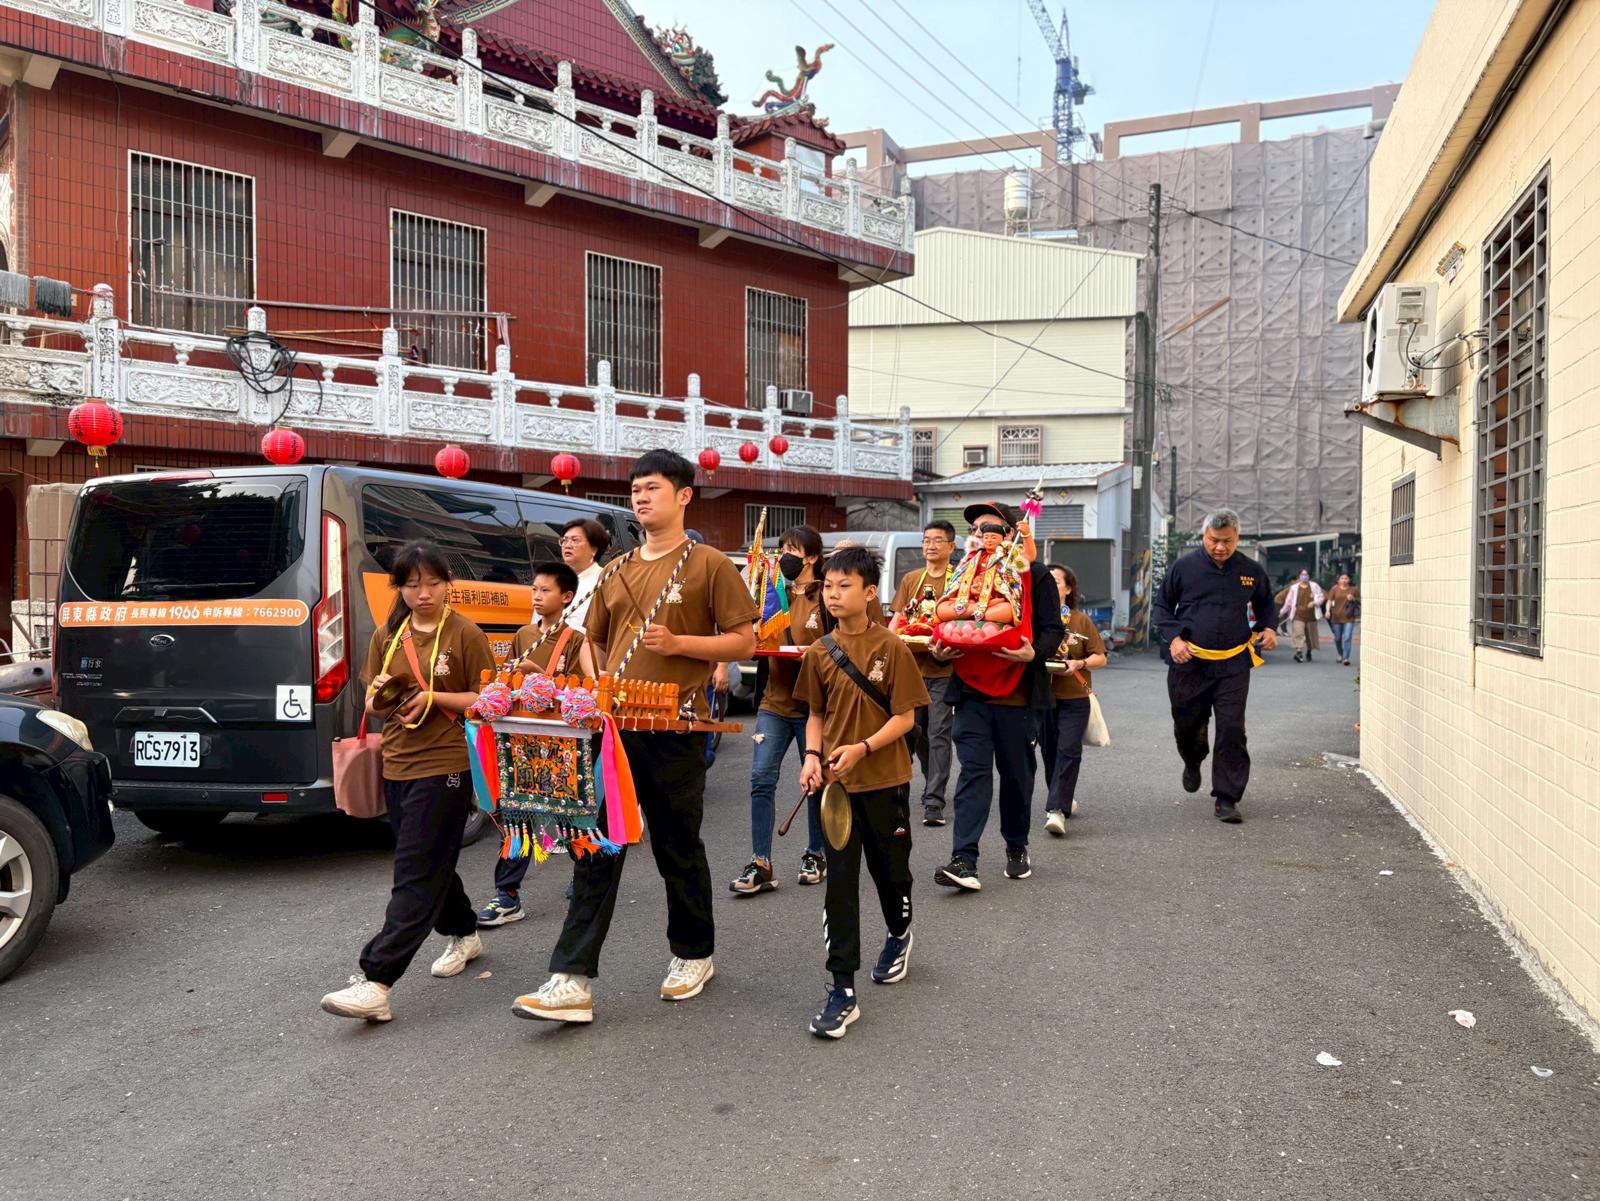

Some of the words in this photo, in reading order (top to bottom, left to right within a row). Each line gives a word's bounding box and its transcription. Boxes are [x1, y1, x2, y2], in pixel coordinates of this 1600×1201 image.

[61, 606, 128, 622] 屏東縣政府
[131, 607, 167, 619] 長照專線
[169, 606, 200, 619] 1966
[136, 740, 198, 761] RCS-7913
